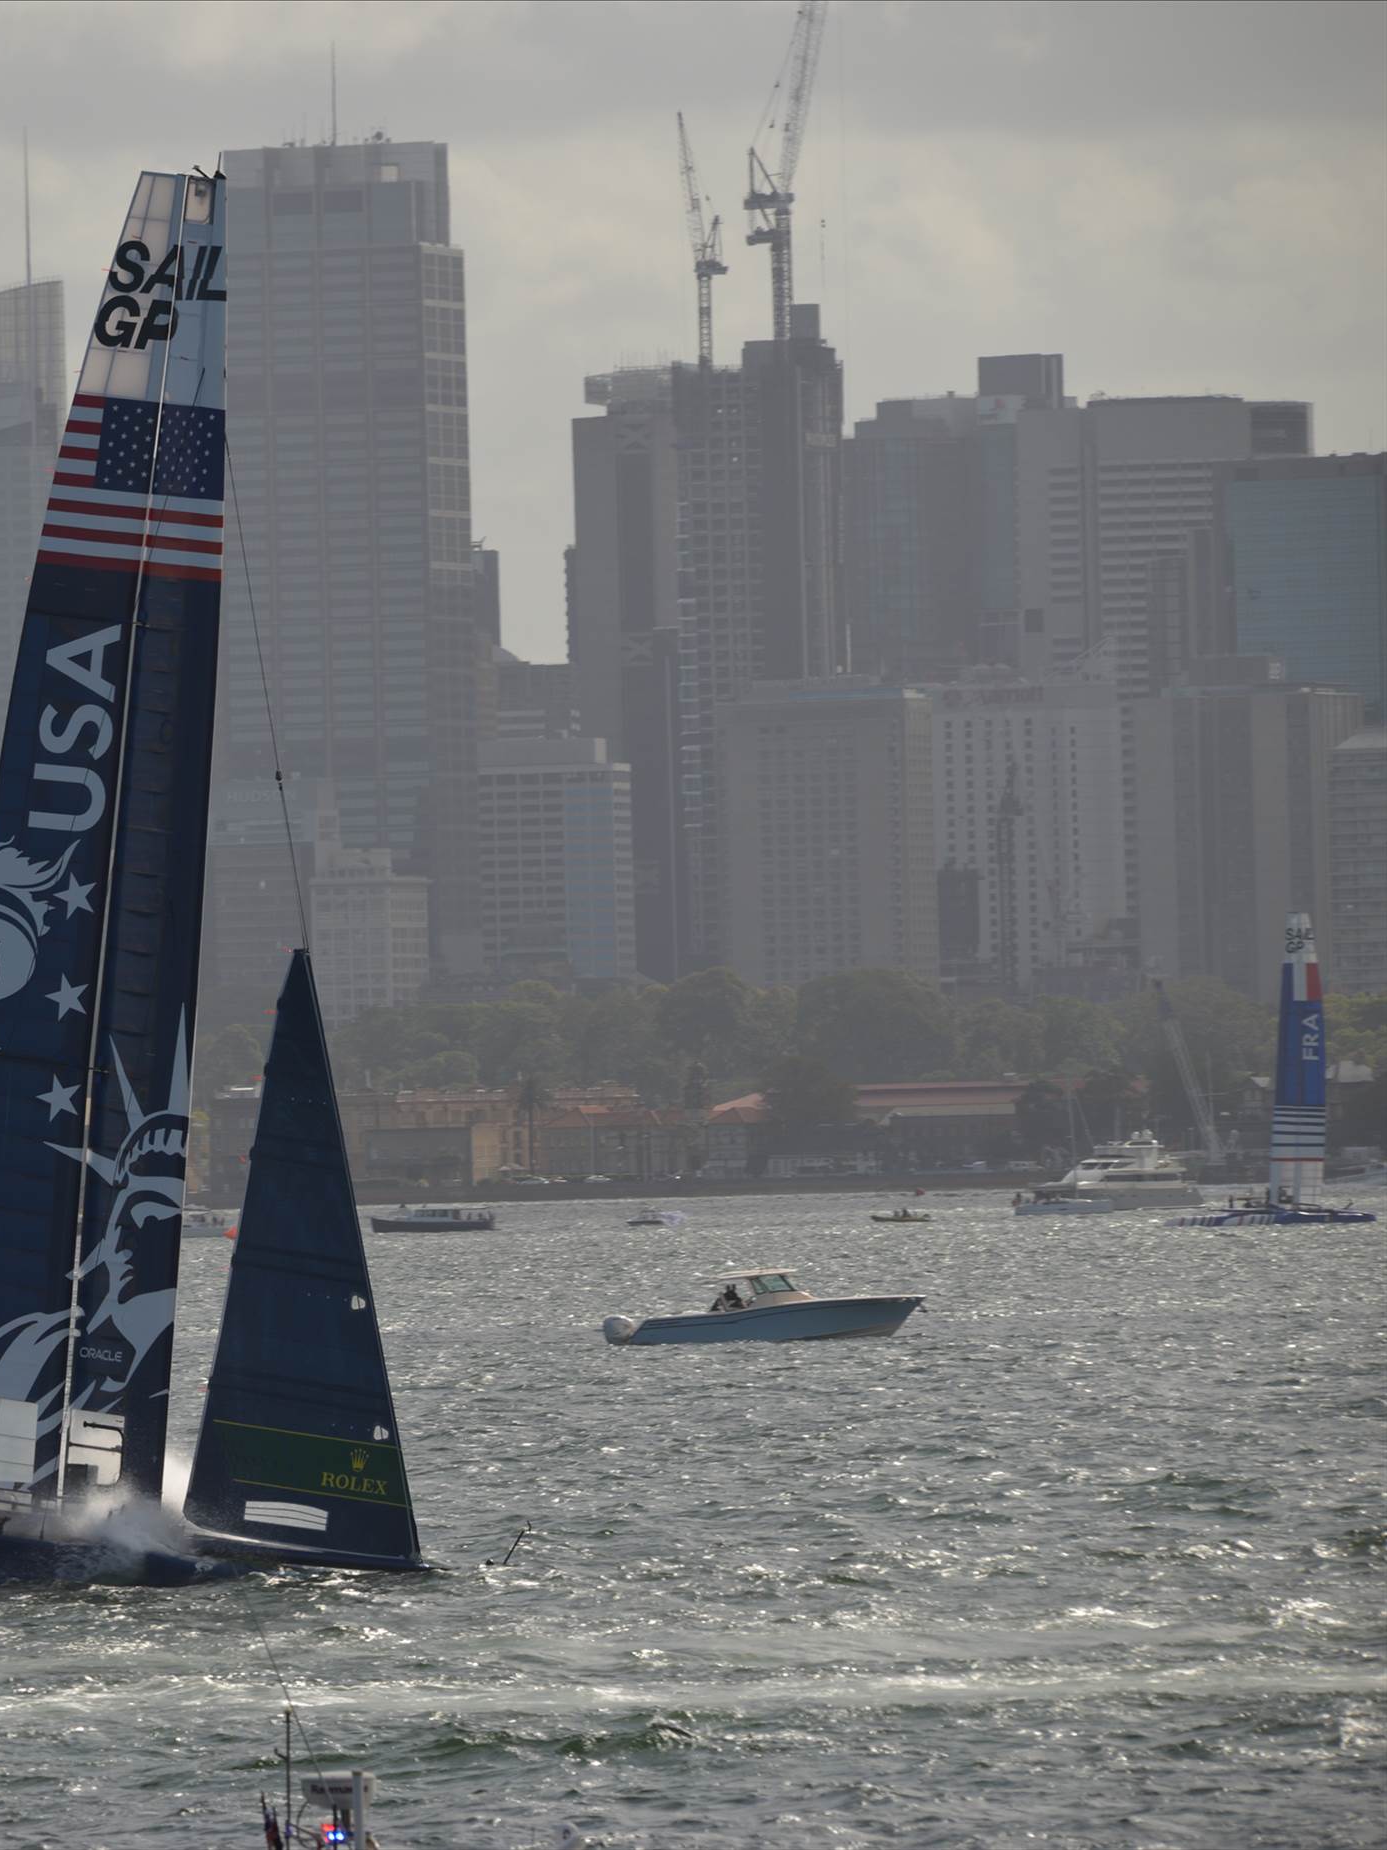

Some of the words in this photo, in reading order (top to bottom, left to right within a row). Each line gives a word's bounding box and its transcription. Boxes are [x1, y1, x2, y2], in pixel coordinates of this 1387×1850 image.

[108, 240, 227, 301] SAIL
[94, 295, 179, 349] GP
[27, 623, 122, 832] USA
[1285, 941, 1305, 954] GP
[1301, 1013, 1320, 1061] FRA
[79, 1346, 123, 1362] ORACLE
[320, 1471, 389, 1496] ROLEX
